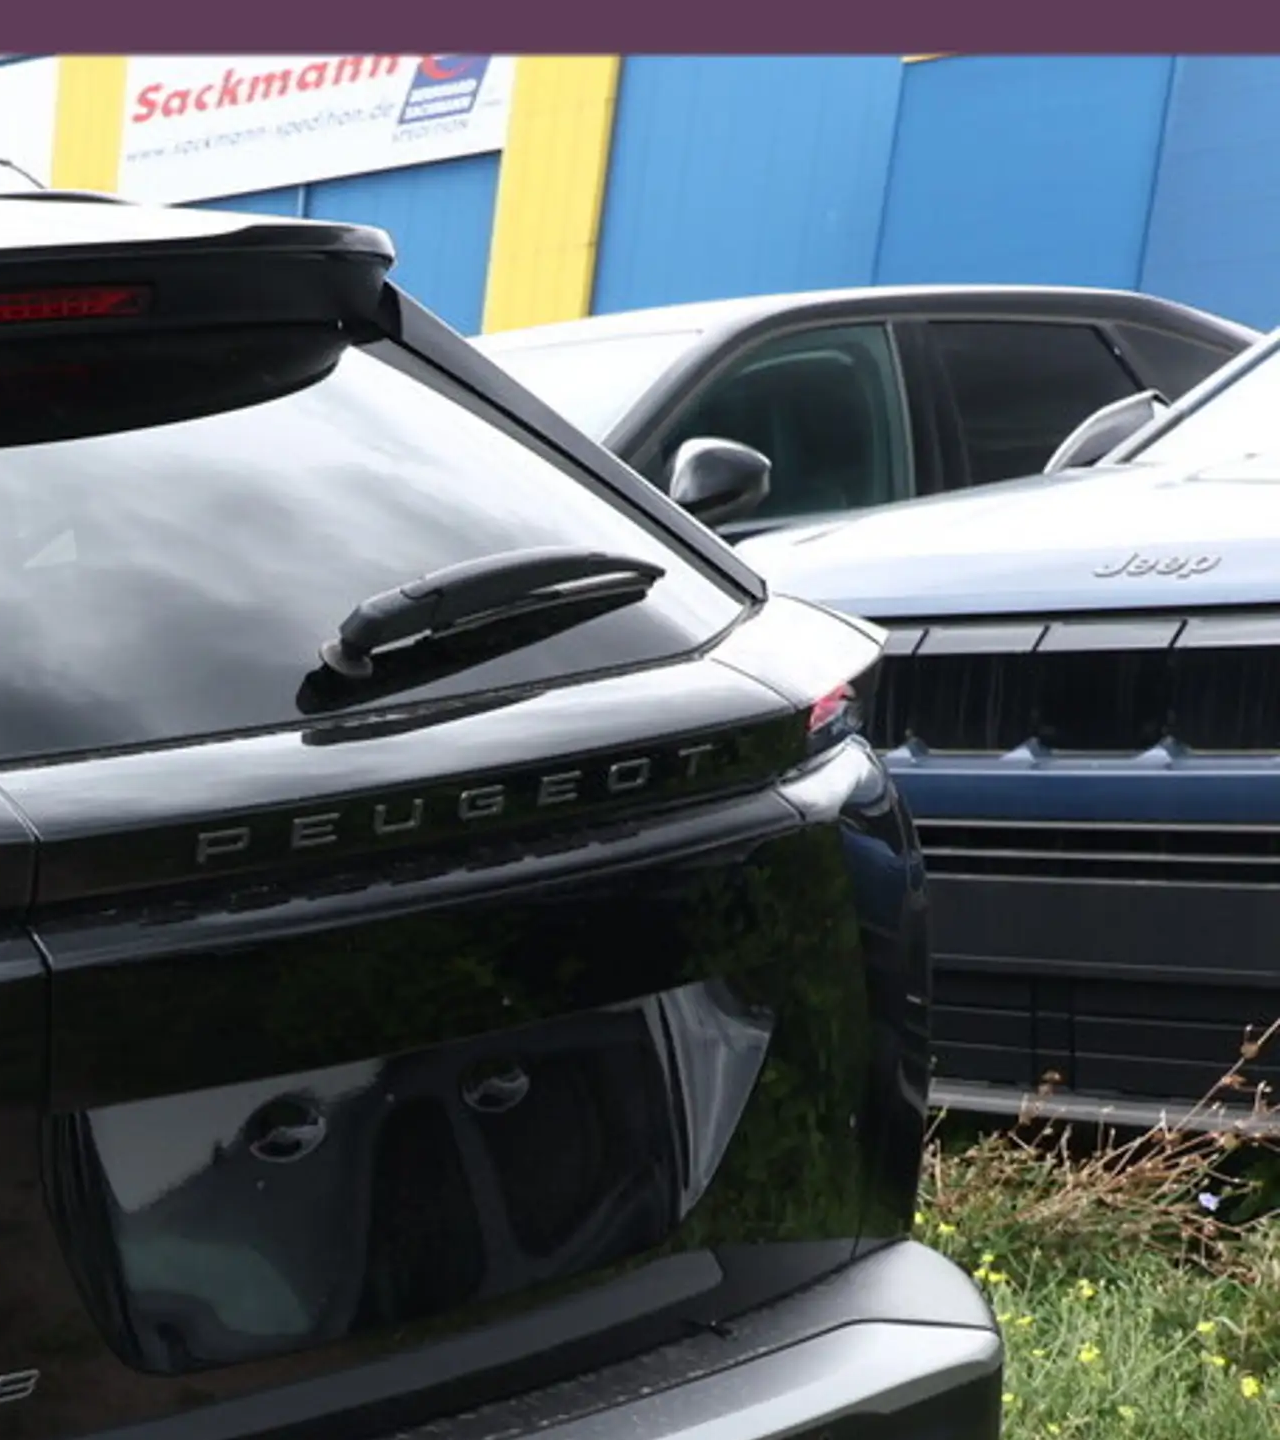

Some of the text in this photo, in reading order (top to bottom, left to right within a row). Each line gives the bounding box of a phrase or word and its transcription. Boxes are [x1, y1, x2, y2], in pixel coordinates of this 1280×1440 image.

[131, 54, 399, 123] Sackmann
[1093, 551, 1222, 581] Jeep
[197, 743, 715, 865] PEUGEOT
